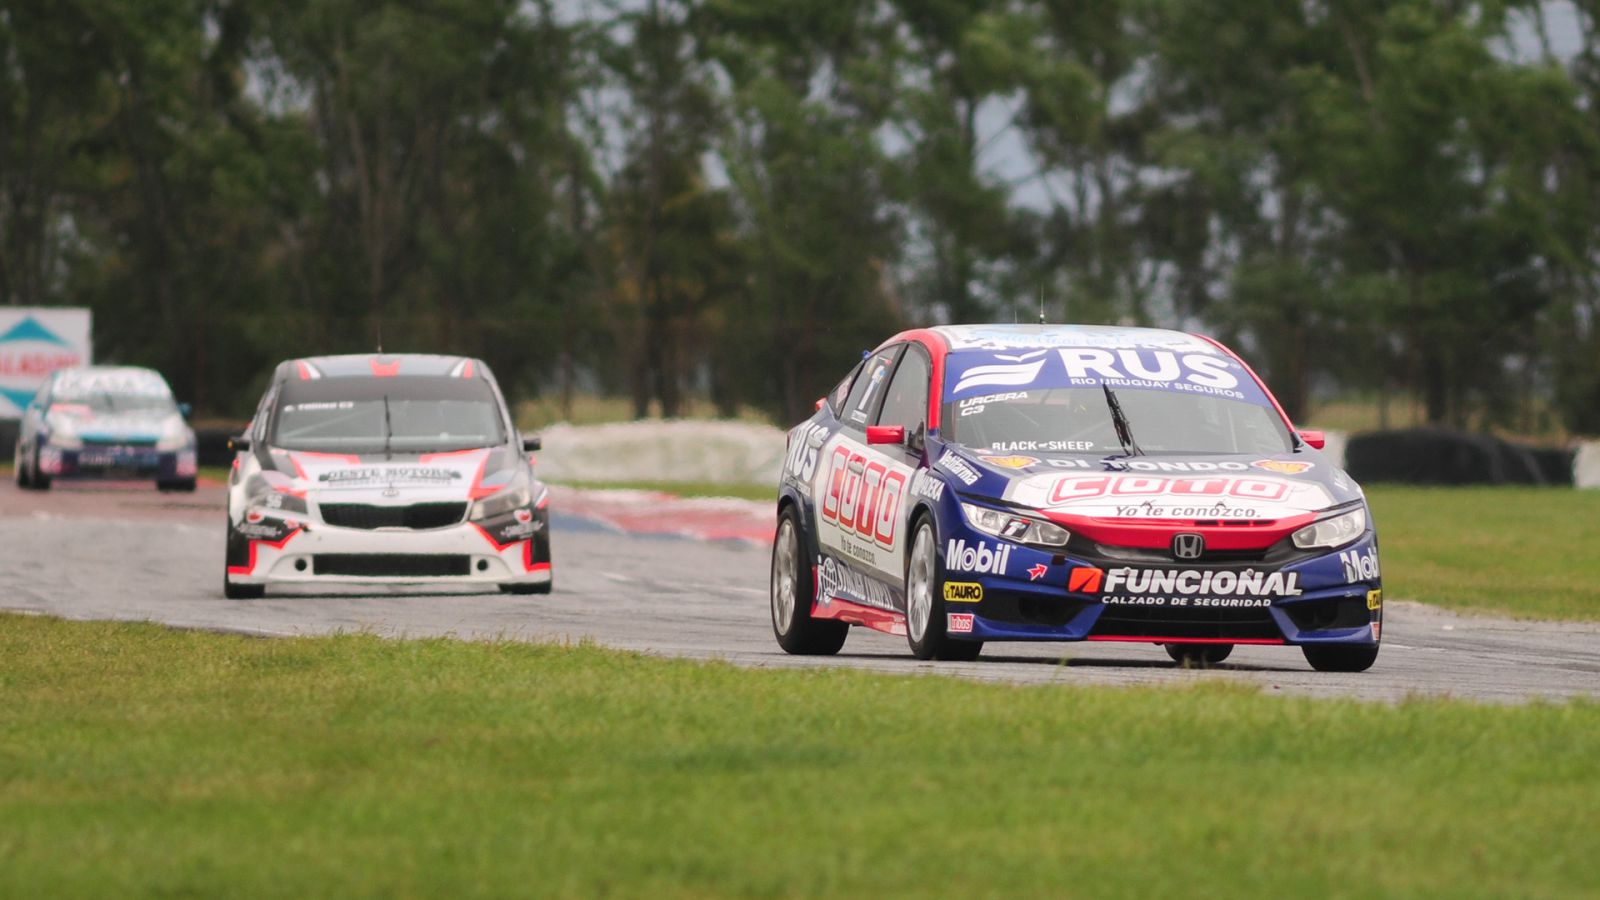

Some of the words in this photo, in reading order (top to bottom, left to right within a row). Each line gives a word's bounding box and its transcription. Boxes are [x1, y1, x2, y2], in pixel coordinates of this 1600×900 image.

[1058, 349, 1239, 389] RUS
[1071, 377, 1096, 386] RIO
[1100, 378, 1171, 389] URUGUAY
[1174, 382, 1245, 400] SEGUROS
[960, 391, 1028, 408] URCERA
[961, 405, 985, 416] C3
[992, 440, 1037, 451] BLACK
[1048, 440, 1094, 451] SHEEP
[1049, 459, 1090, 468] DI
[1099, 459, 1249, 471] TONDO
[328, 467, 380, 480] OESTE
[385, 467, 452, 480] MOTORS
[822, 444, 906, 546] COTO
[1052, 476, 1289, 500] COTO
[1116, 506, 1138, 517] Yo
[1171, 505, 1262, 518] conozco.
[946, 538, 1010, 575] Mobil
[1104, 568, 1303, 596] FUNCIONAL
[950, 585, 981, 599] TAURO
[1101, 595, 1165, 606] CALZADO
[1170, 596, 1187, 606] DE
[1193, 597, 1272, 608] SEGURIDAD
